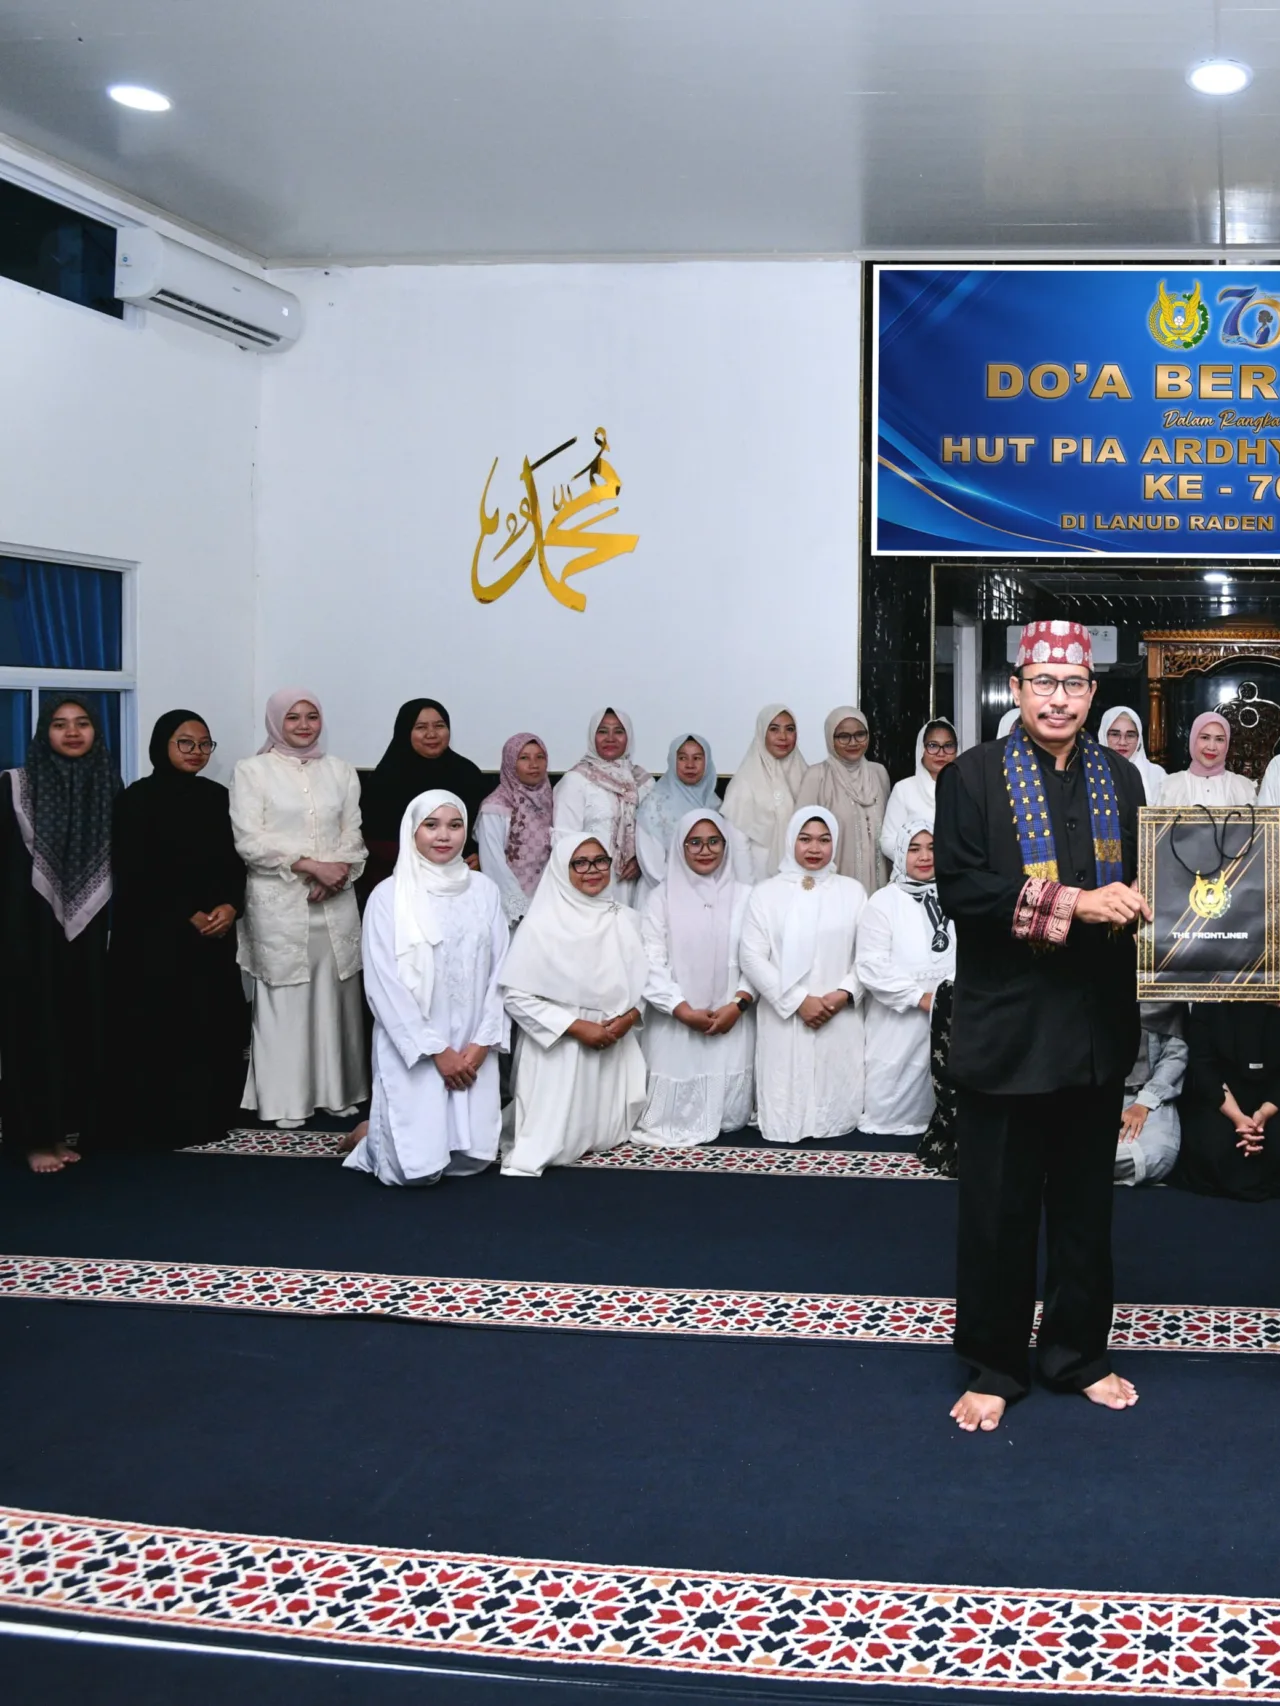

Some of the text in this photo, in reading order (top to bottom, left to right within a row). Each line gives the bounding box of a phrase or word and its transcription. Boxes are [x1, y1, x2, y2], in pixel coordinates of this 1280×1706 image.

[1163, 409, 1215, 429] Dalam
[942, 437, 1035, 464] HUT
[1052, 438, 1127, 464] PIA
[1143, 474, 1203, 500] KE
[1061, 514, 1085, 529] DI
[1094, 515, 1180, 530] LANUD
[1189, 515, 1273, 531] RADEN
[1172, 931, 1249, 939] THE FRONTLINER
